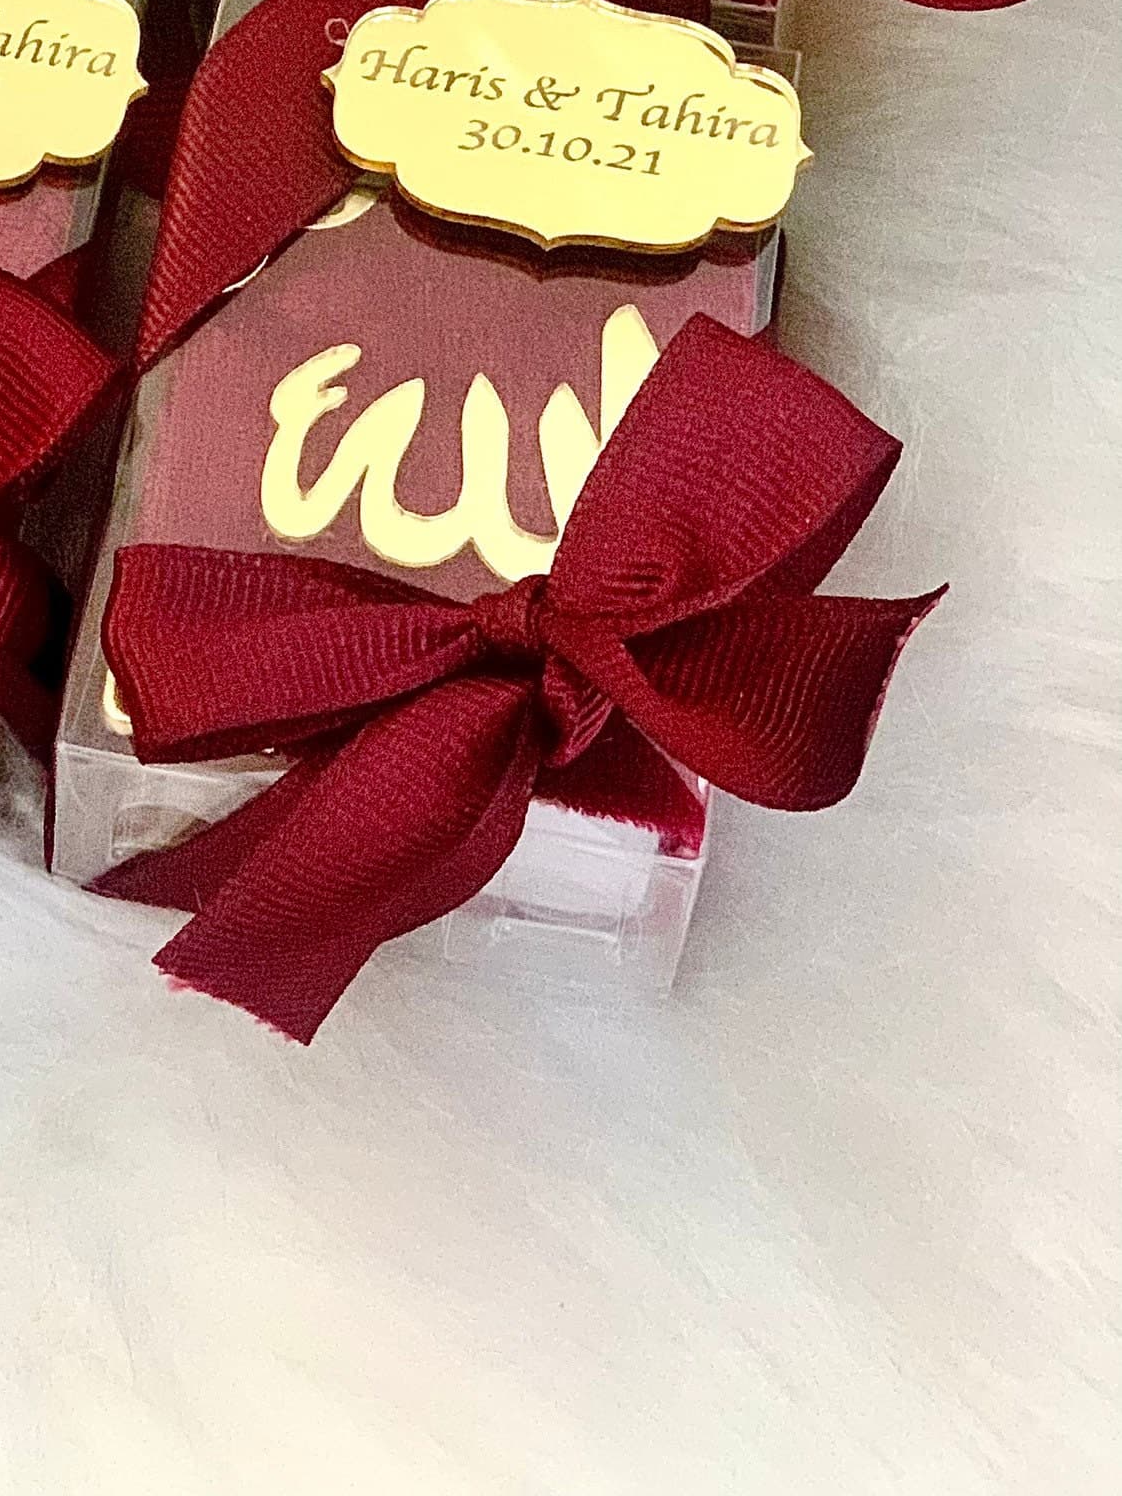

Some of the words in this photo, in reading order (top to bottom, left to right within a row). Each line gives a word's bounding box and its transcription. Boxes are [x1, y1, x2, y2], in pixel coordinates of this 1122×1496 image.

[360, 45, 505, 100] Haris
[523, 76, 580, 110] &
[596, 84, 777, 147] Tahira
[458, 120, 661, 174] 30.10.21
